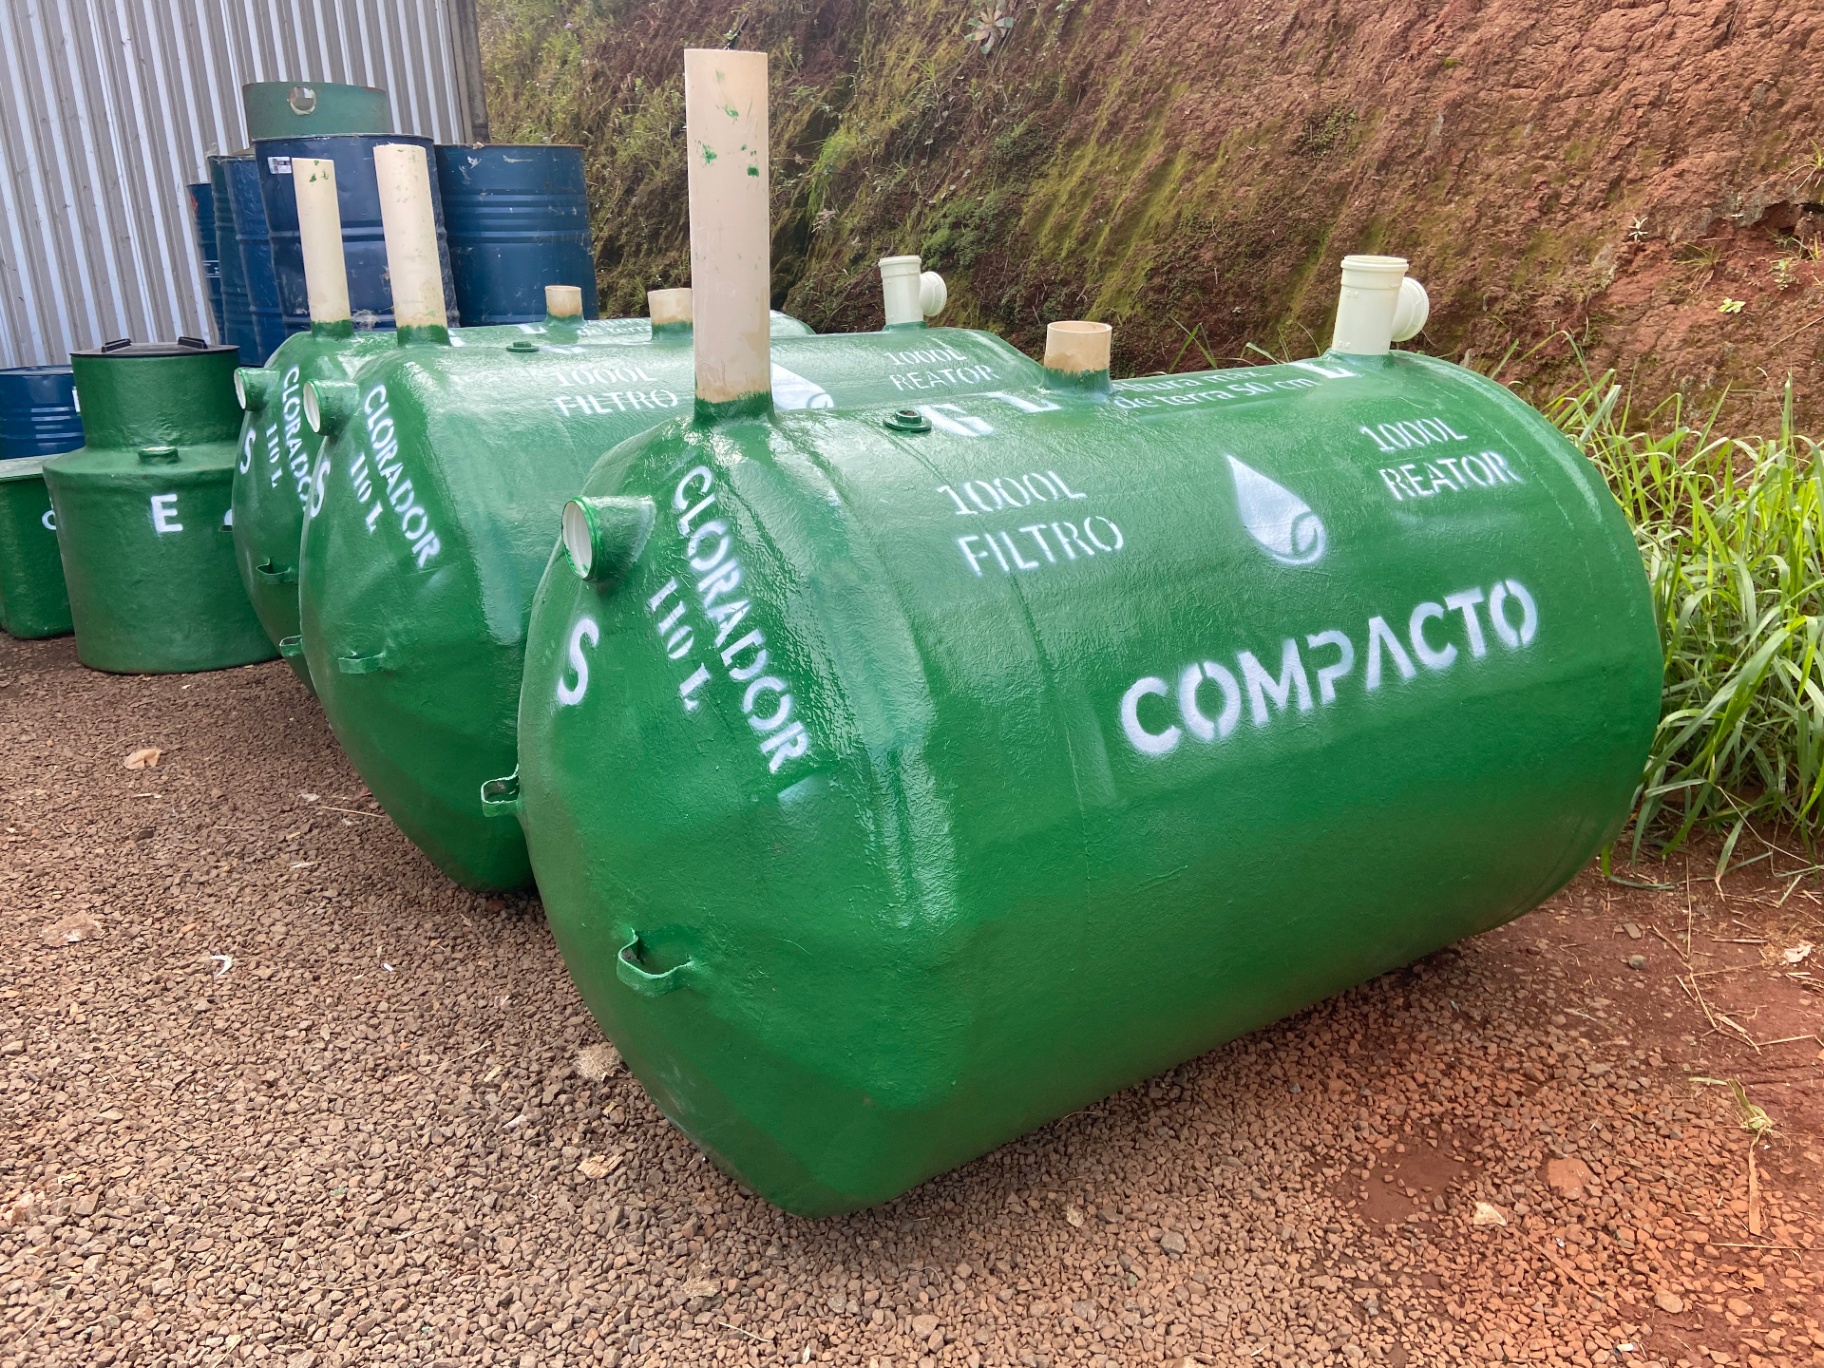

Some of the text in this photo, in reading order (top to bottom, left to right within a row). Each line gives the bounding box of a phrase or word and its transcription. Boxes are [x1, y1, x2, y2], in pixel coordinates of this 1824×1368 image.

[552, 367, 657, 386] 1000L
[885, 345, 967, 366] 1000L
[889, 364, 1001, 391] REATOR
[554, 389, 678, 417] FILTRO
[1112, 377, 1322, 409] de terra 50 cm
[239, 428, 256, 475] S
[265, 423, 281, 465] 110
[282, 366, 313, 513] CLORADO
[1360, 416, 1468, 453] 1000L
[309, 459, 331, 519] S
[350, 452, 384, 535] 110 L
[364, 384, 441, 568] CLORADOR
[936, 470, 1088, 516] 1000L
[1378, 450, 1524, 501] REATOR
[151, 492, 184, 534] E
[957, 515, 1124, 578] FILTRO
[648, 576, 712, 712] 110 L
[673, 465, 810, 775] CLORADOR
[556, 616, 600, 706] S
[1119, 577, 1540, 757] COMPACTO
